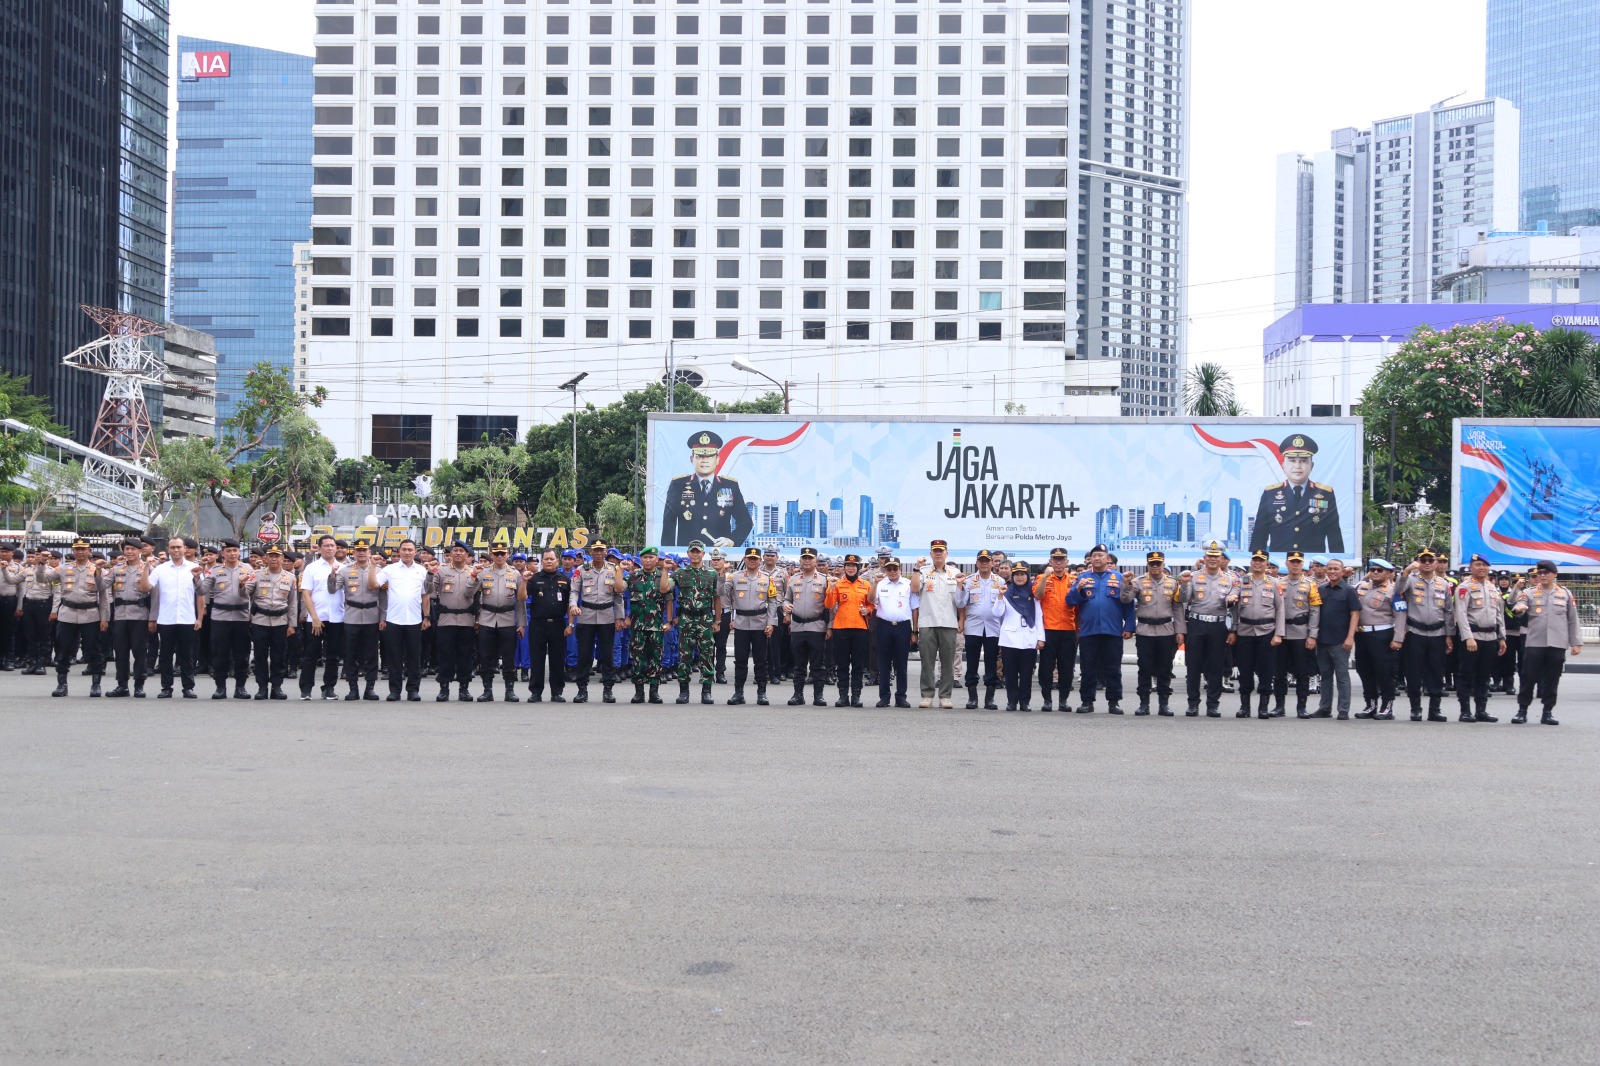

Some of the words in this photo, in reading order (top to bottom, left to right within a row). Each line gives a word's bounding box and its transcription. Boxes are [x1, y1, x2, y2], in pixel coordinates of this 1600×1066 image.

[185, 55, 227, 73] AIA
[1563, 316, 1600, 326] YAMAHA
[926, 441, 999, 481] JAGA
[372, 504, 475, 519] LAPANGAN
[424, 526, 590, 549] DITLANTAS
[1056, 534, 1073, 542] Jaya
